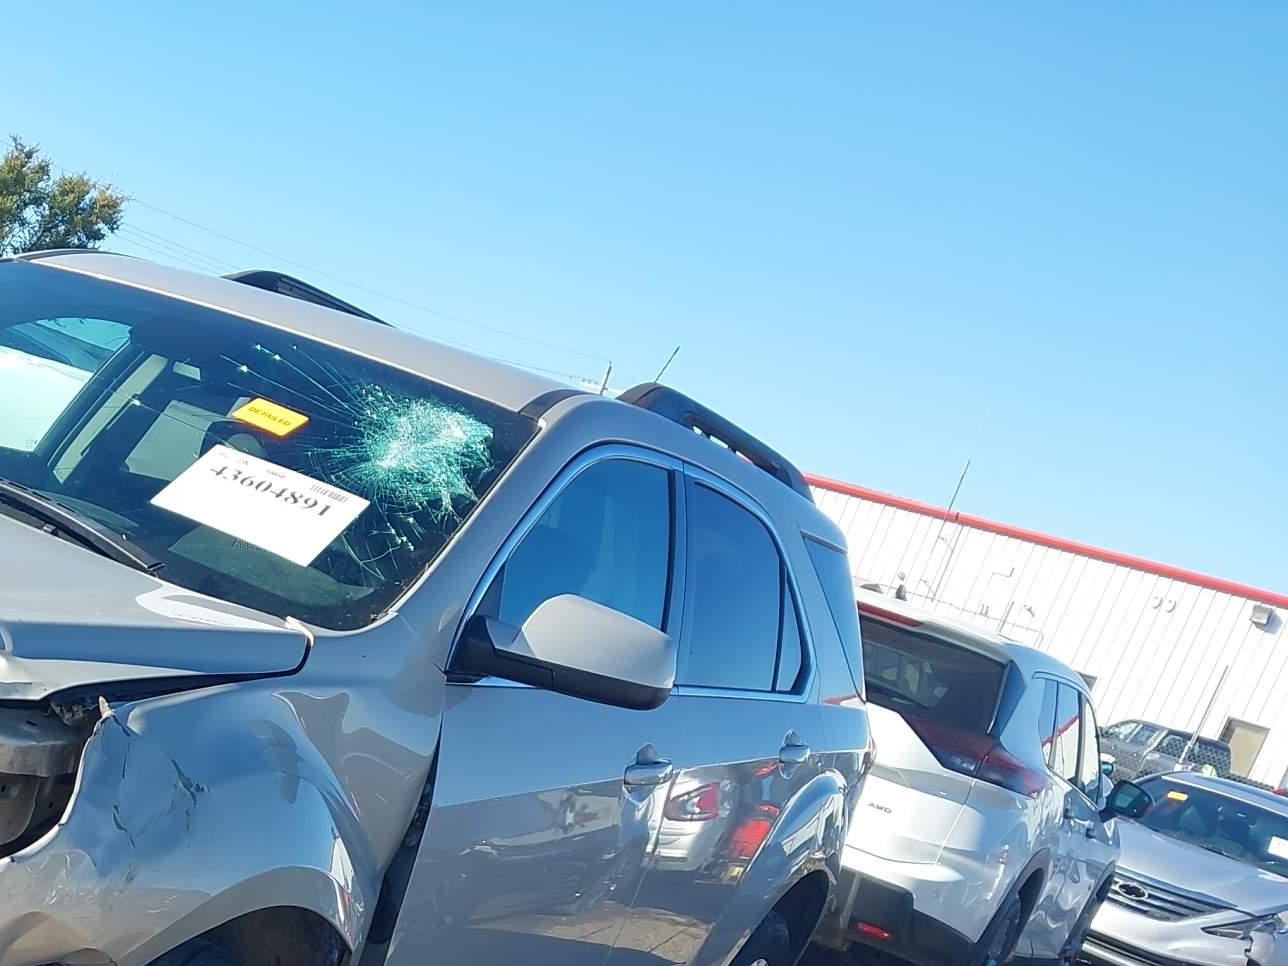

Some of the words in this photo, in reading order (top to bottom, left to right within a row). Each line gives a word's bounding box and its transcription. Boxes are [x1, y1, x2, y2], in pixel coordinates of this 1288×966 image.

[248, 406, 292, 426] DETAILED
[209, 465, 332, 517] 43604891
[868, 802, 893, 814] AWD
